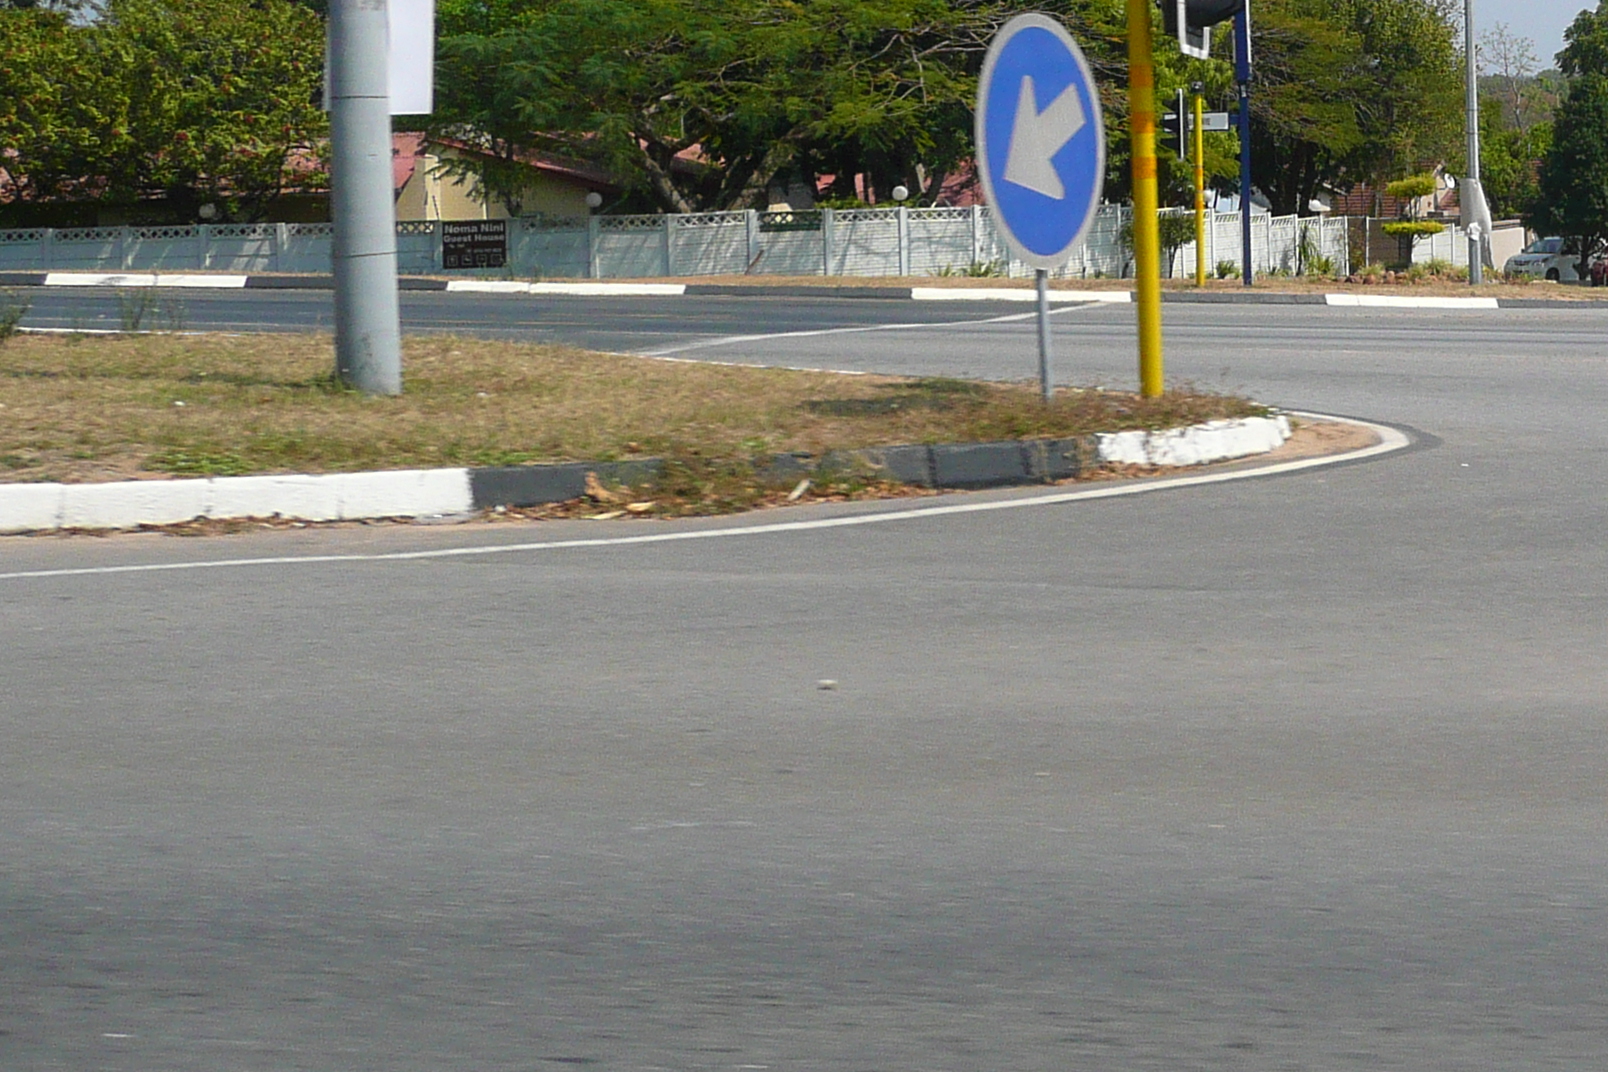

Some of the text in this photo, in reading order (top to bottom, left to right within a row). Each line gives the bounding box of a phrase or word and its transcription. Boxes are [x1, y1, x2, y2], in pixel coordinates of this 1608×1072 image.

[444, 223, 504, 234] Noma Nini
[443, 235, 471, 243] Guest
